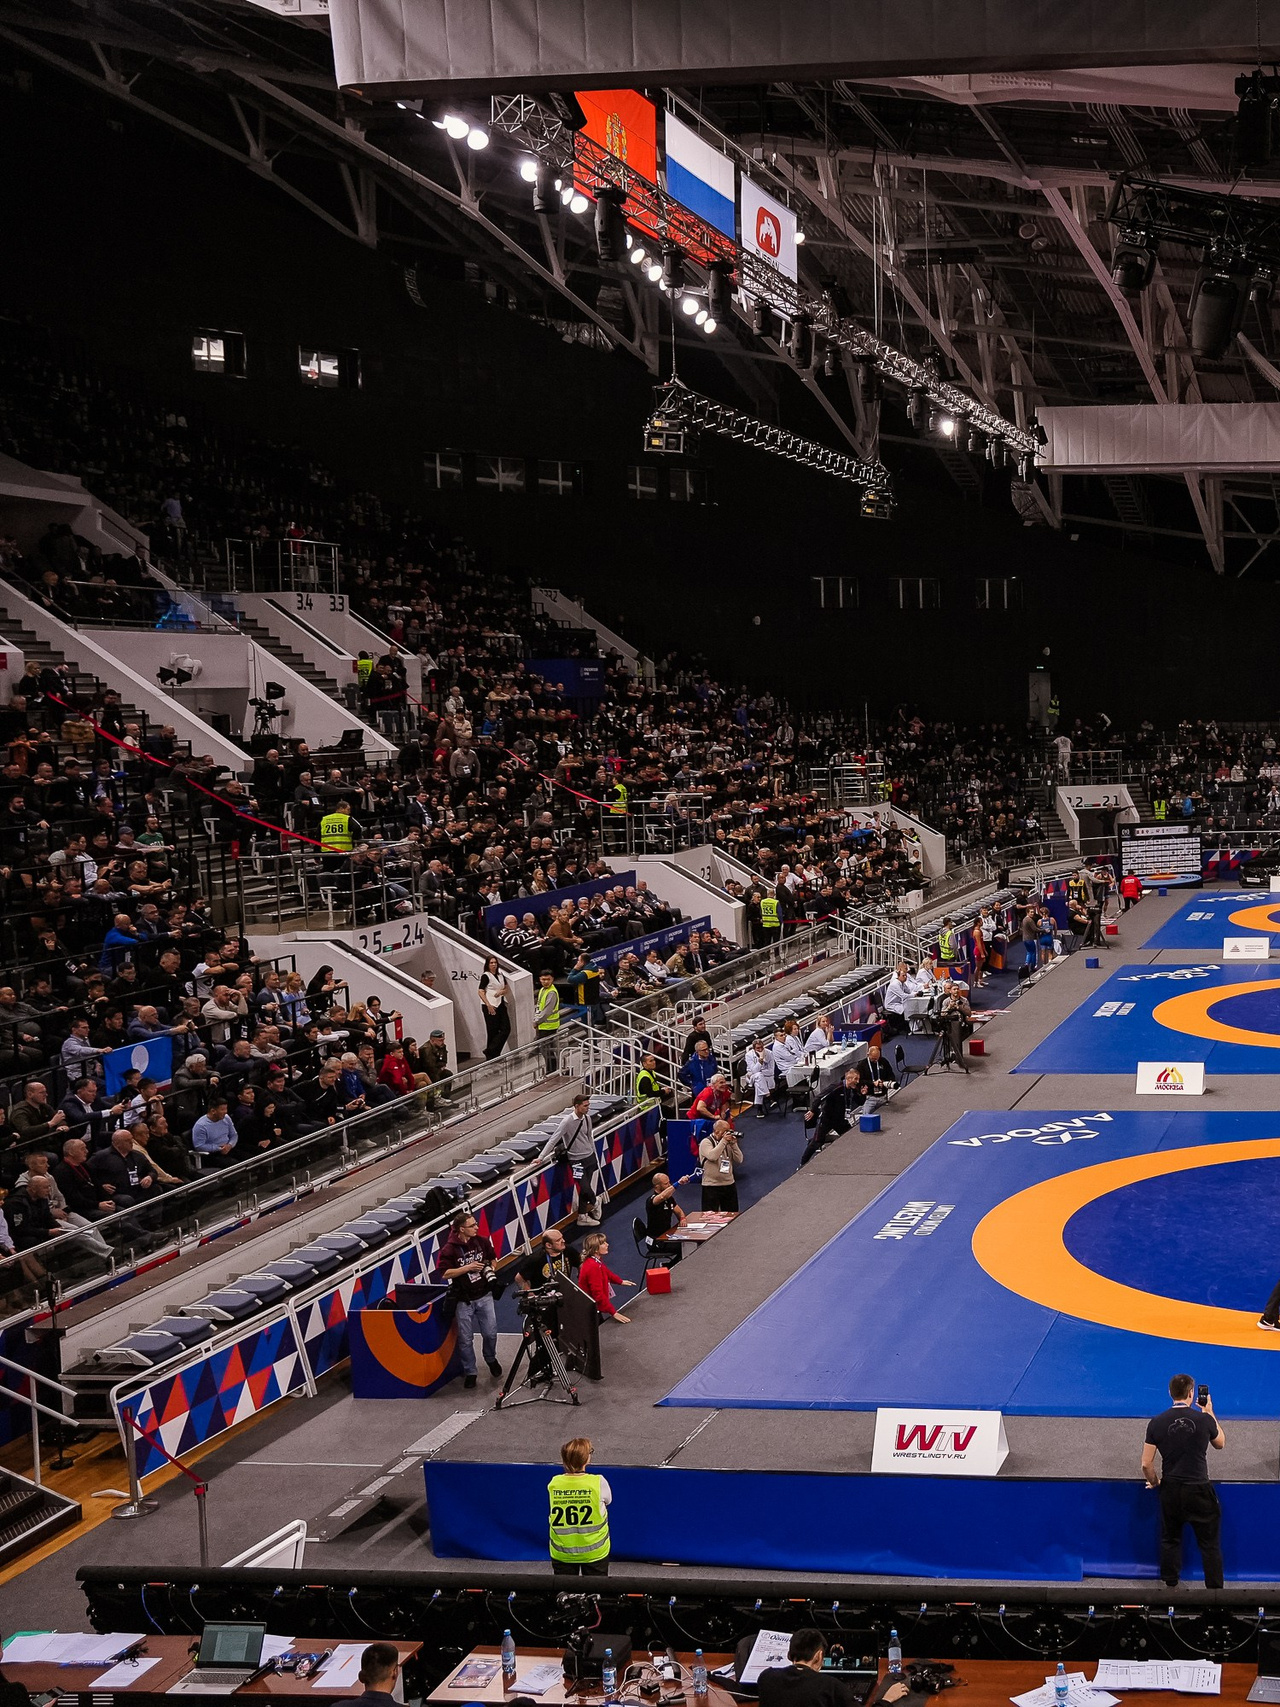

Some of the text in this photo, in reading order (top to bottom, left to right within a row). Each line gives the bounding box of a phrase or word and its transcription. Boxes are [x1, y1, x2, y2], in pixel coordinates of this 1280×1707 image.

[296, 593, 313, 610] 3.4
[330, 595, 345, 612] 3.3
[1102, 795, 1120, 807] 21
[325, 823, 344, 833] 268
[358, 922, 425, 955] 25 2.4
[451, 970, 468, 981] 2.4
[873, 1201, 937, 1240] WRESTLING
[895, 1424, 978, 1451] WTV
[892, 1452, 967, 1460] WRESTLINGTV.RU
[552, 1505, 593, 1527] 262
